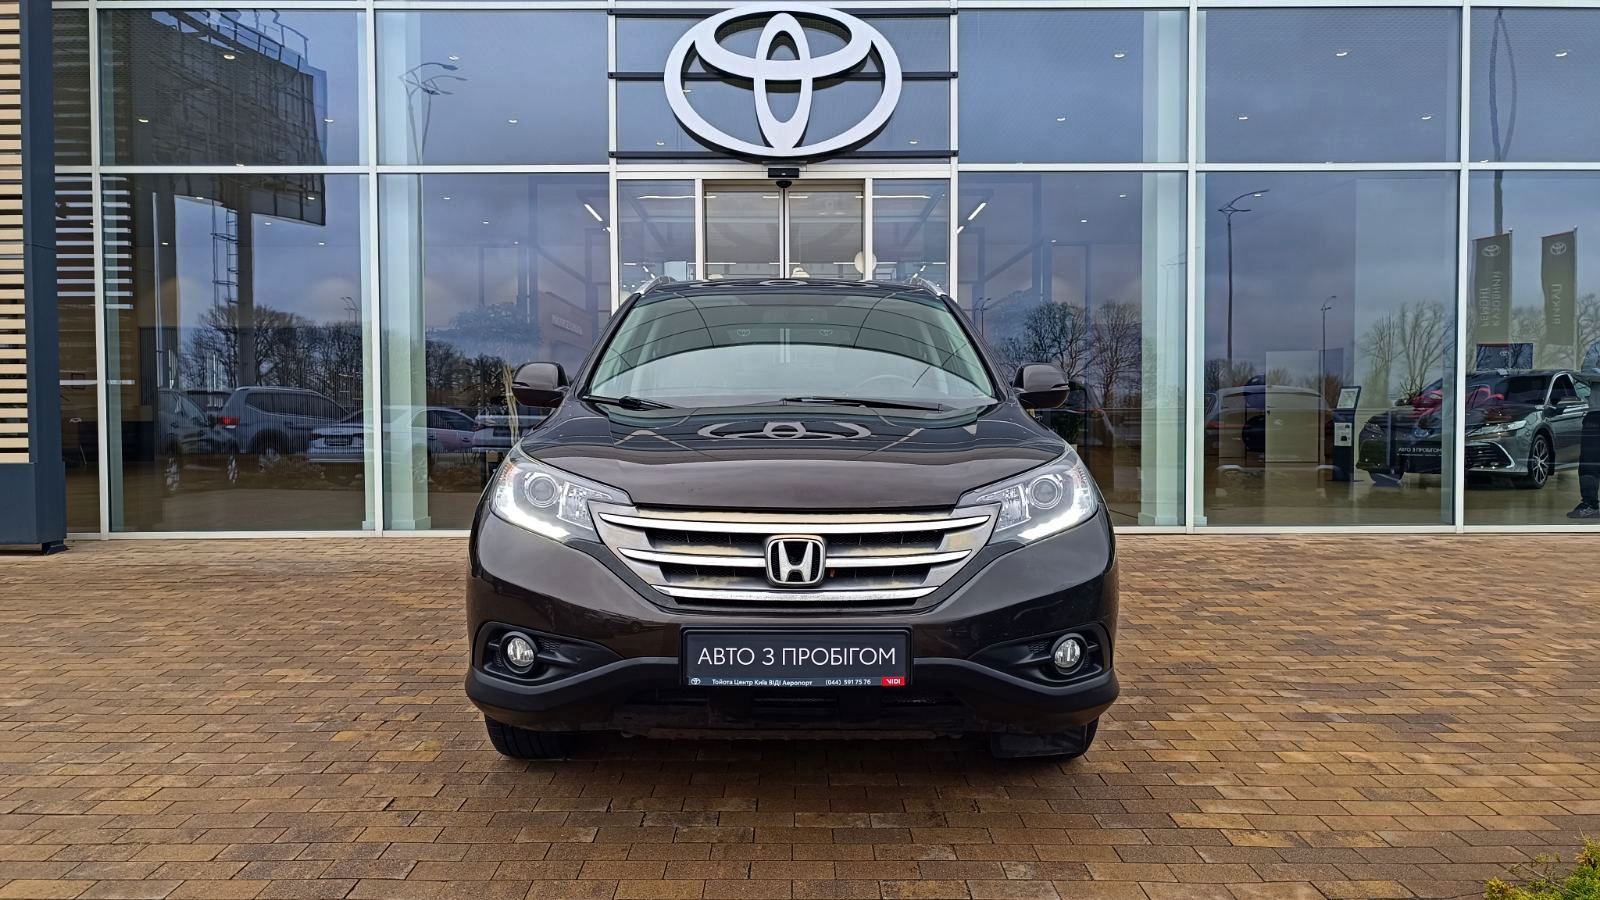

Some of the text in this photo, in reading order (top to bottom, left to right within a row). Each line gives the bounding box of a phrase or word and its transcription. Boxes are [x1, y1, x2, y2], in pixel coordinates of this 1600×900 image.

[697, 647, 896, 666] АВТО З ПРОБІГОМ
